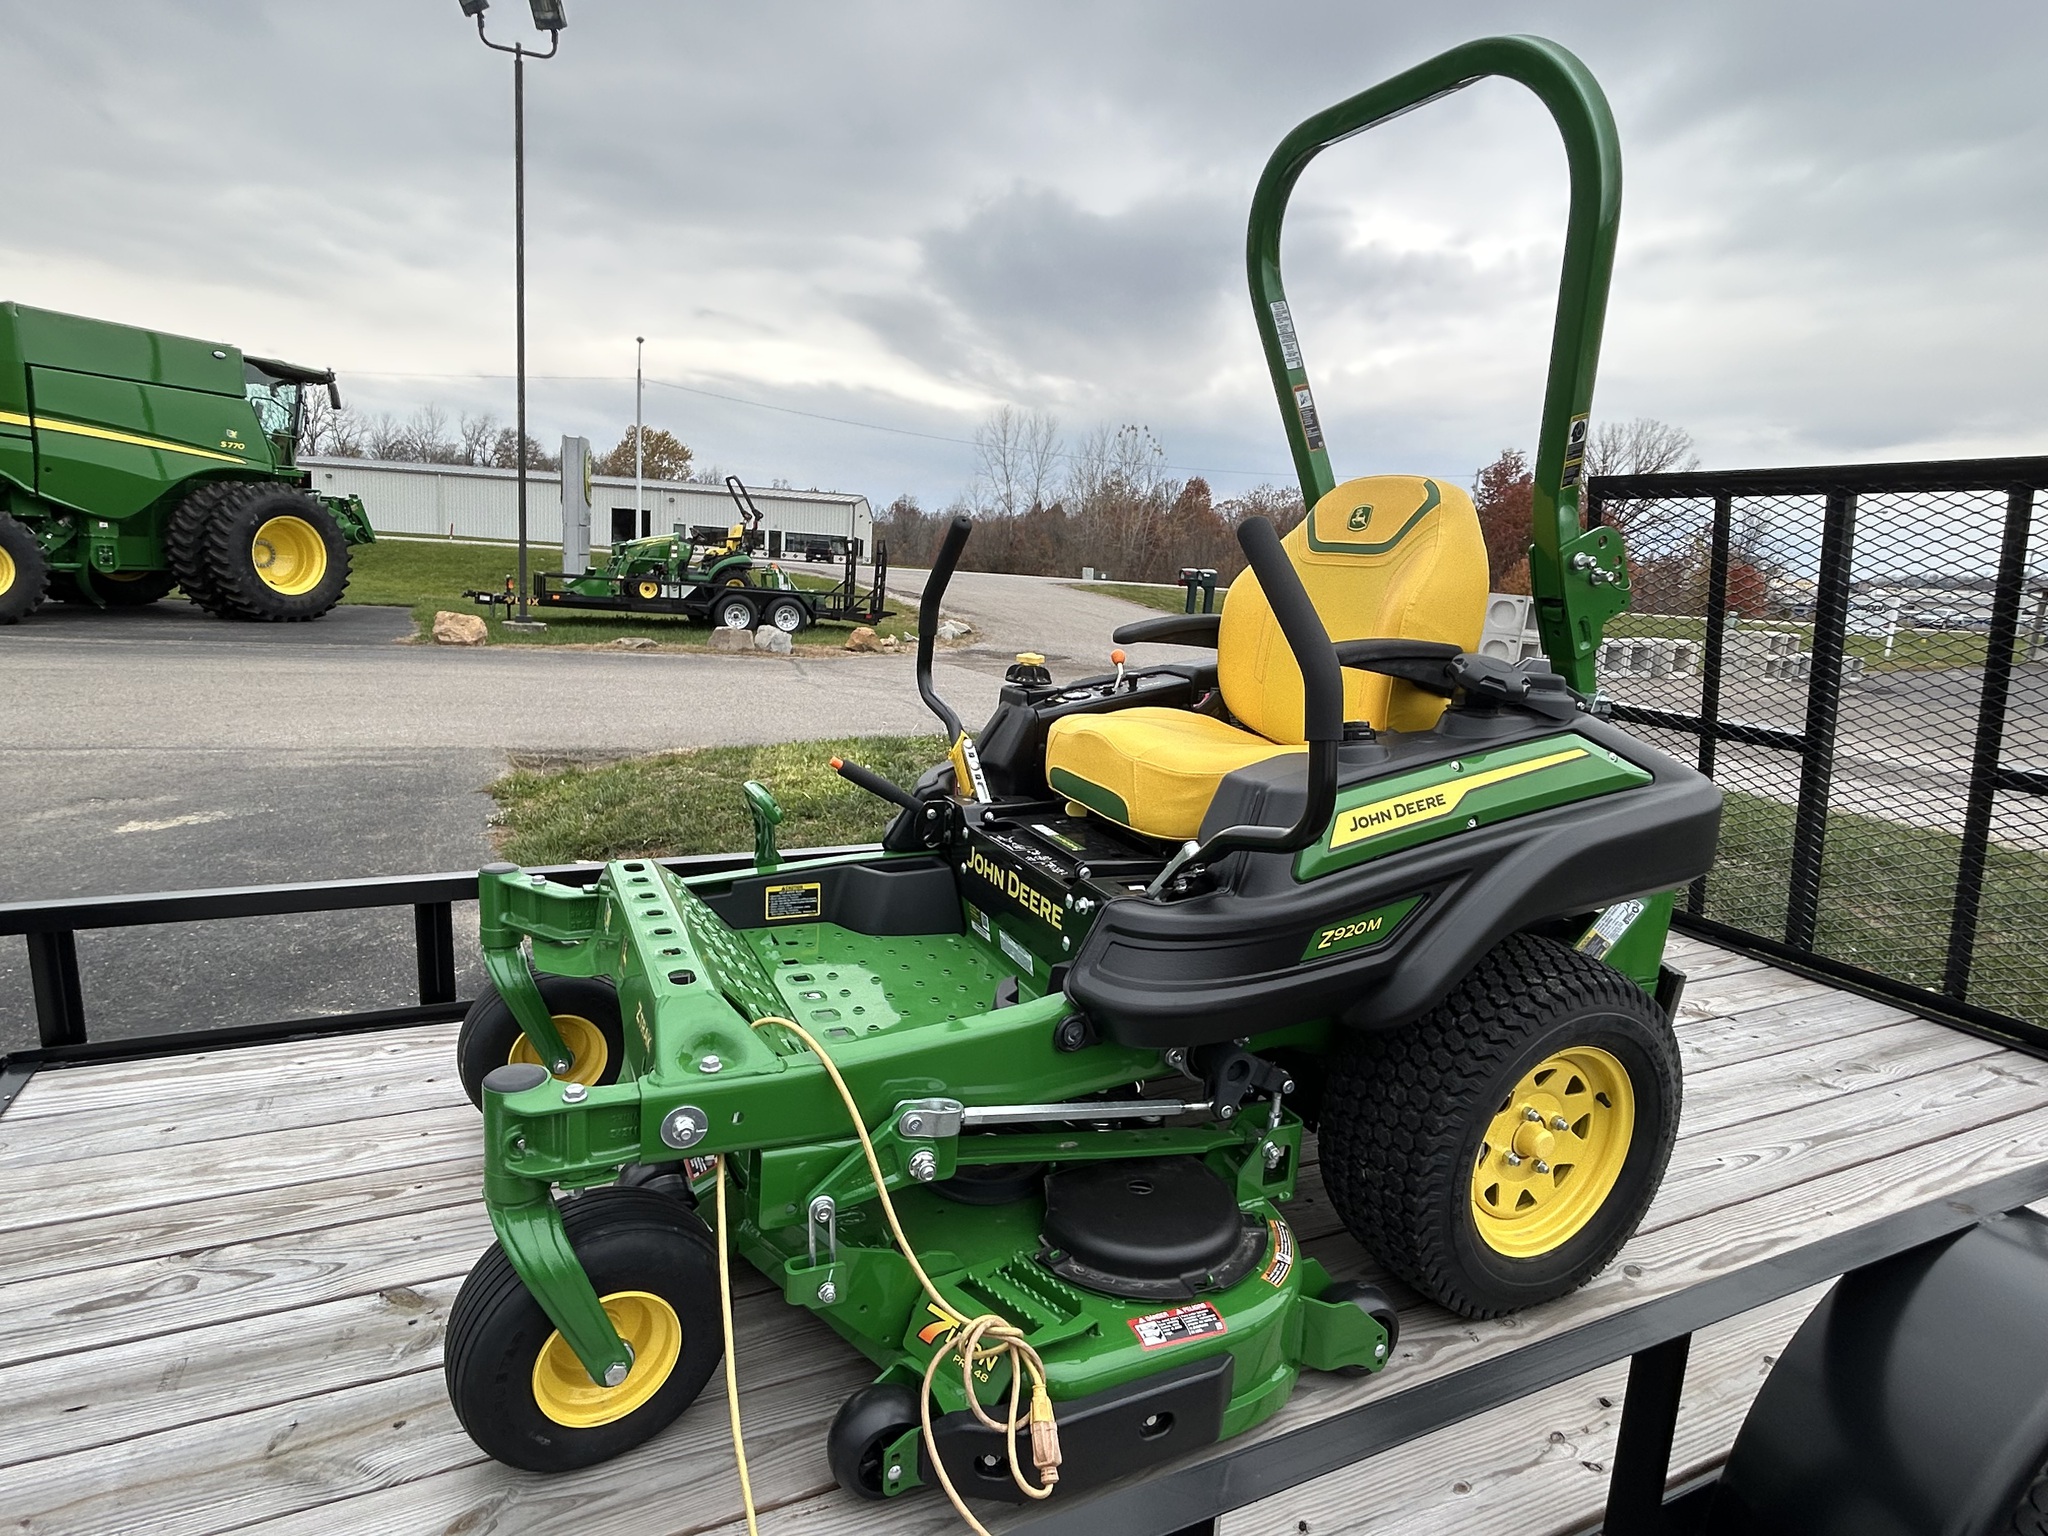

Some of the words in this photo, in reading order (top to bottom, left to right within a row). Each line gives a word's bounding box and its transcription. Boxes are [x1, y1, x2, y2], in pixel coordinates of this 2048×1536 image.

[1350, 809, 1392, 833] JOHN
[1393, 793, 1447, 819] DEERE
[966, 845, 1005, 891] JOHN
[1007, 869, 1064, 931] DEERE
[1317, 916, 1383, 950] Z920M
[973, 1368, 989, 1384] 48
